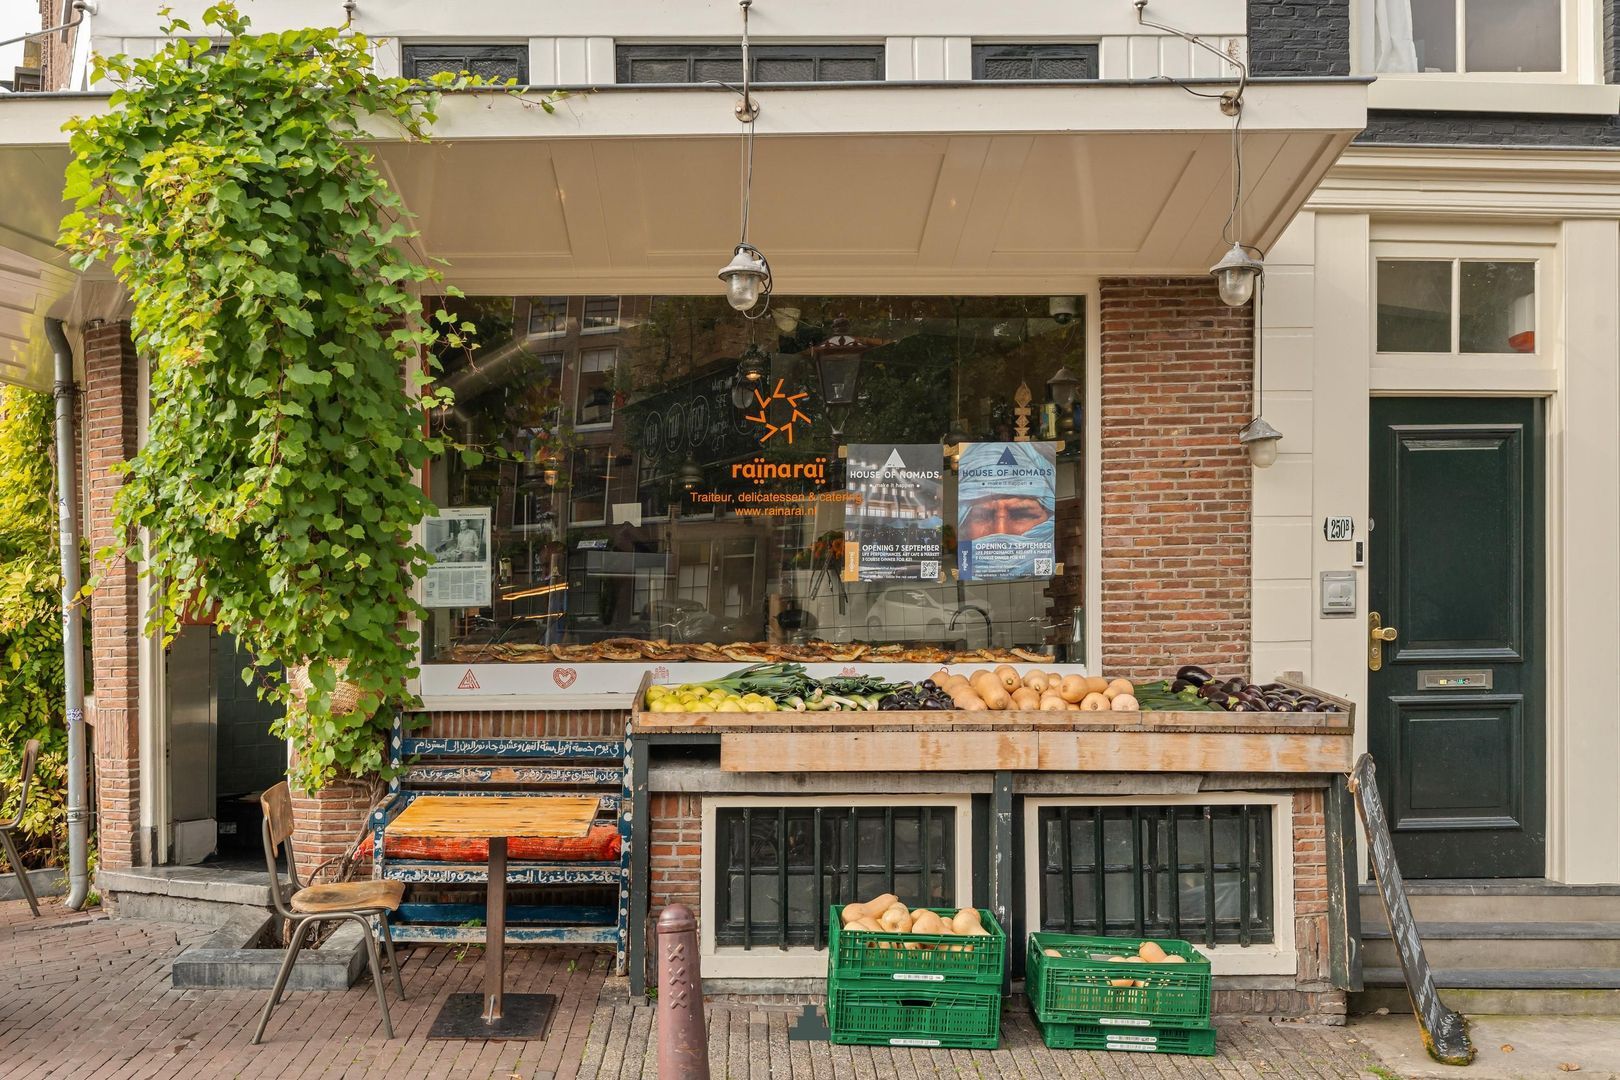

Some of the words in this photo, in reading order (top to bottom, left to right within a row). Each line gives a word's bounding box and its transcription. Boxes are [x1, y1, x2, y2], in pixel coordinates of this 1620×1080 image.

[850, 471, 881, 479] HOUSE
[884, 471, 896, 479] OF
[899, 470, 940, 479] NOMADS
[962, 469, 993, 477] HOUSE
[996, 469, 1009, 477] OF
[1012, 468, 1052, 477] NOMADS
[690, 491, 735, 504] Traiteur,
[738, 491, 805, 503] delicatessen
[808, 491, 817, 503] &
[819, 491, 863, 505] catering
[862, 544, 894, 552] OPENING
[895, 544, 899, 552] 7
[901, 544, 940, 552] SEPTEMBER
[975, 542, 1007, 550] OPENING
[1014, 542, 1052, 550] SEPTEMBER
